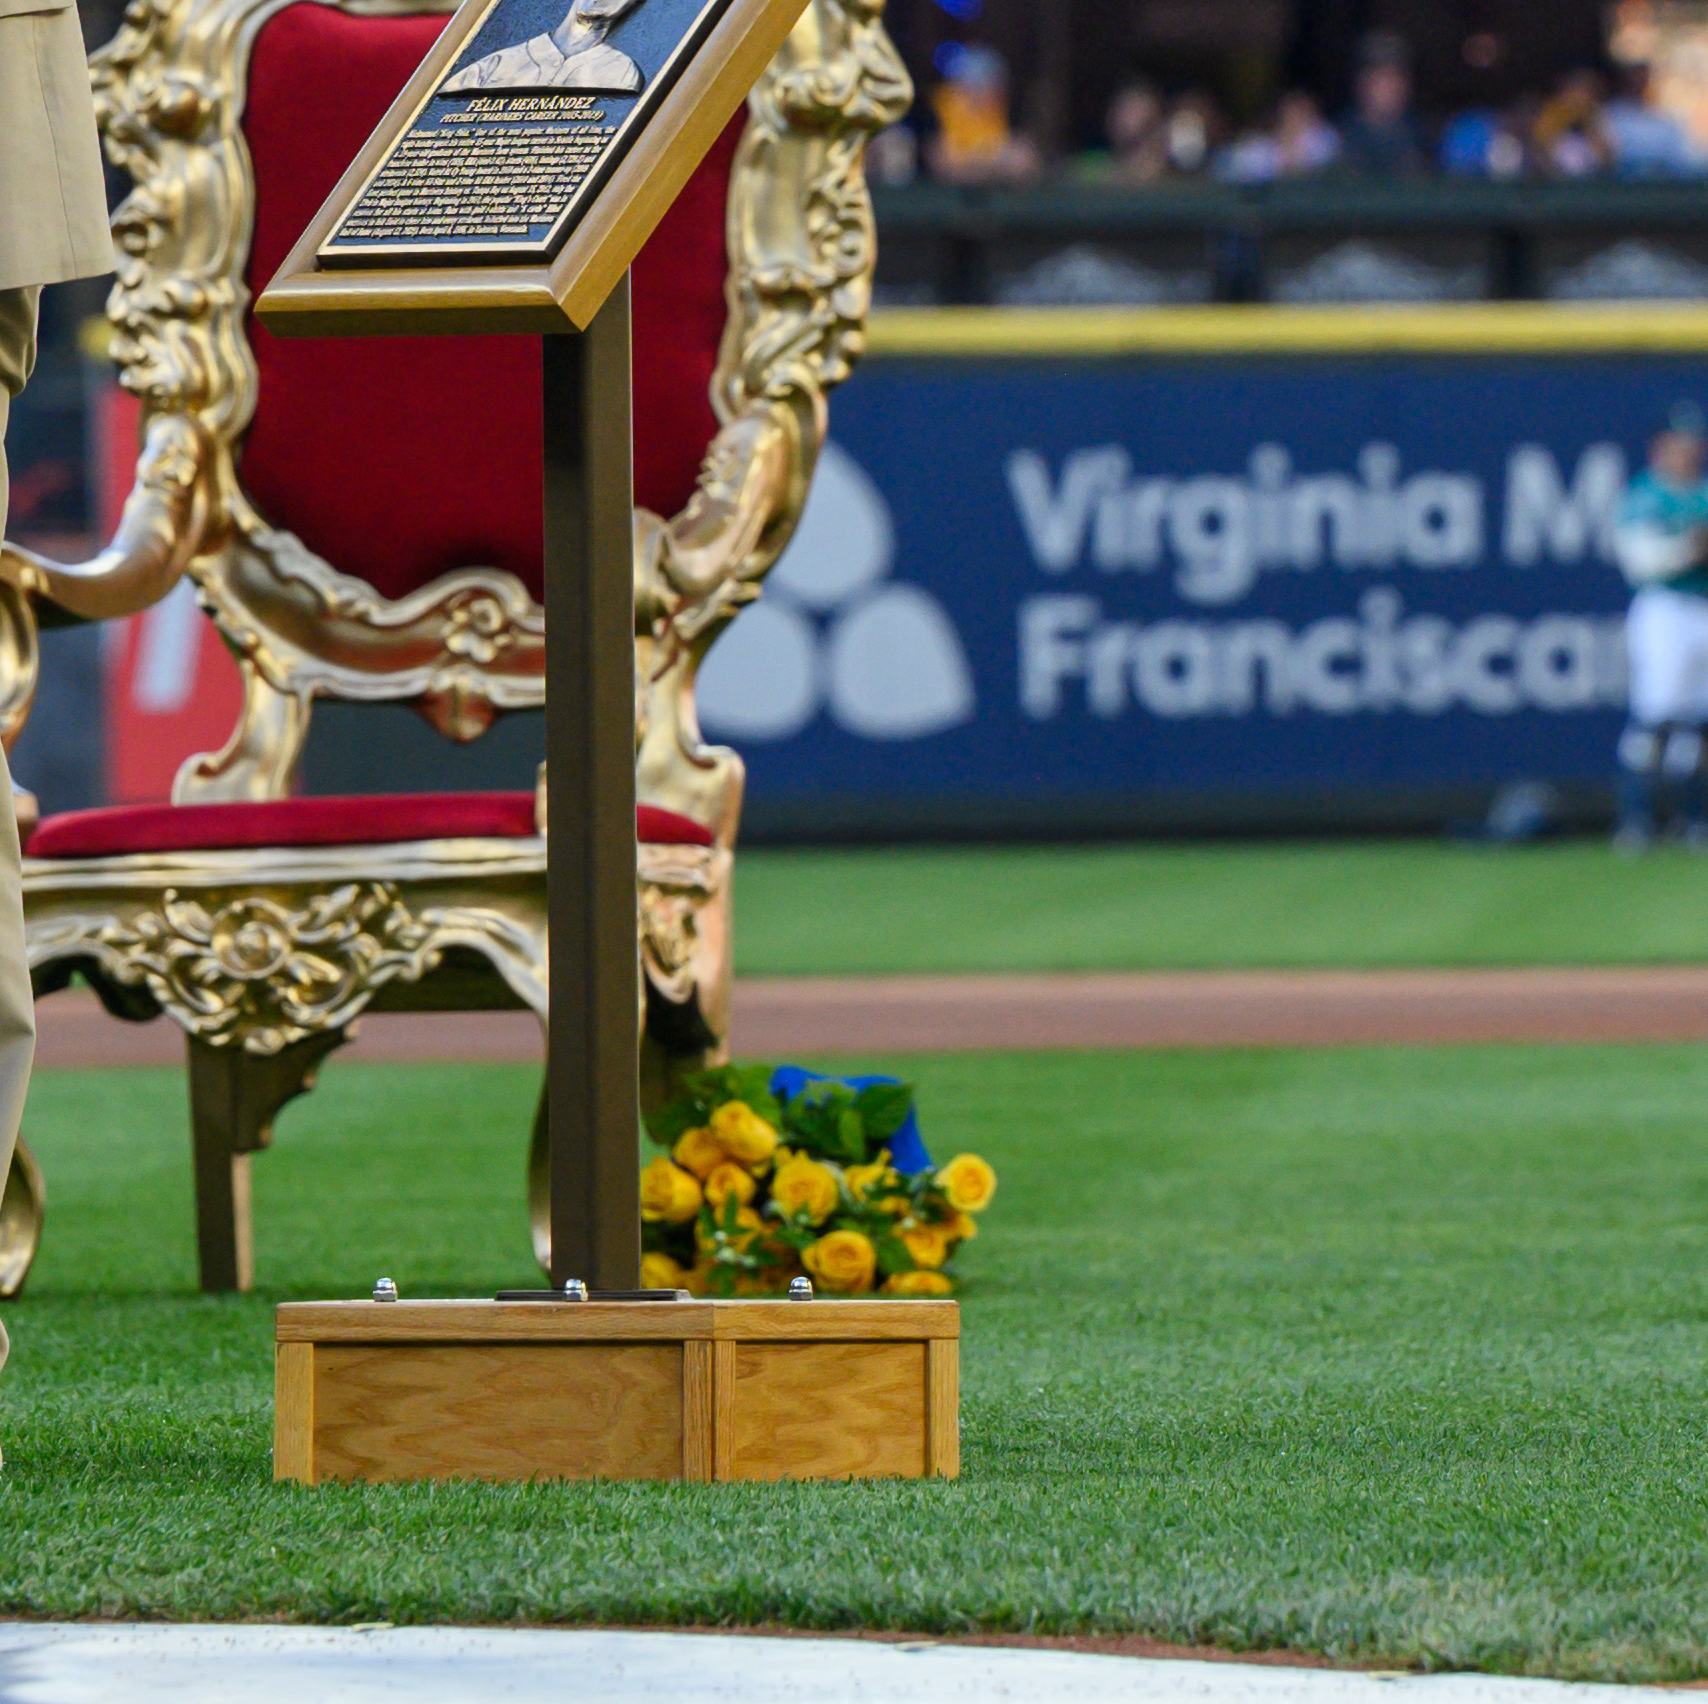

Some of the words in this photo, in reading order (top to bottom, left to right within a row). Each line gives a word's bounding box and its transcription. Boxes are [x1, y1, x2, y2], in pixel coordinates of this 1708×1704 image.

[465, 96, 509, 112] FÉLIX
[507, 95, 597, 112] HERNÁNDEZ
[1002, 441, 1486, 605] Virginia
